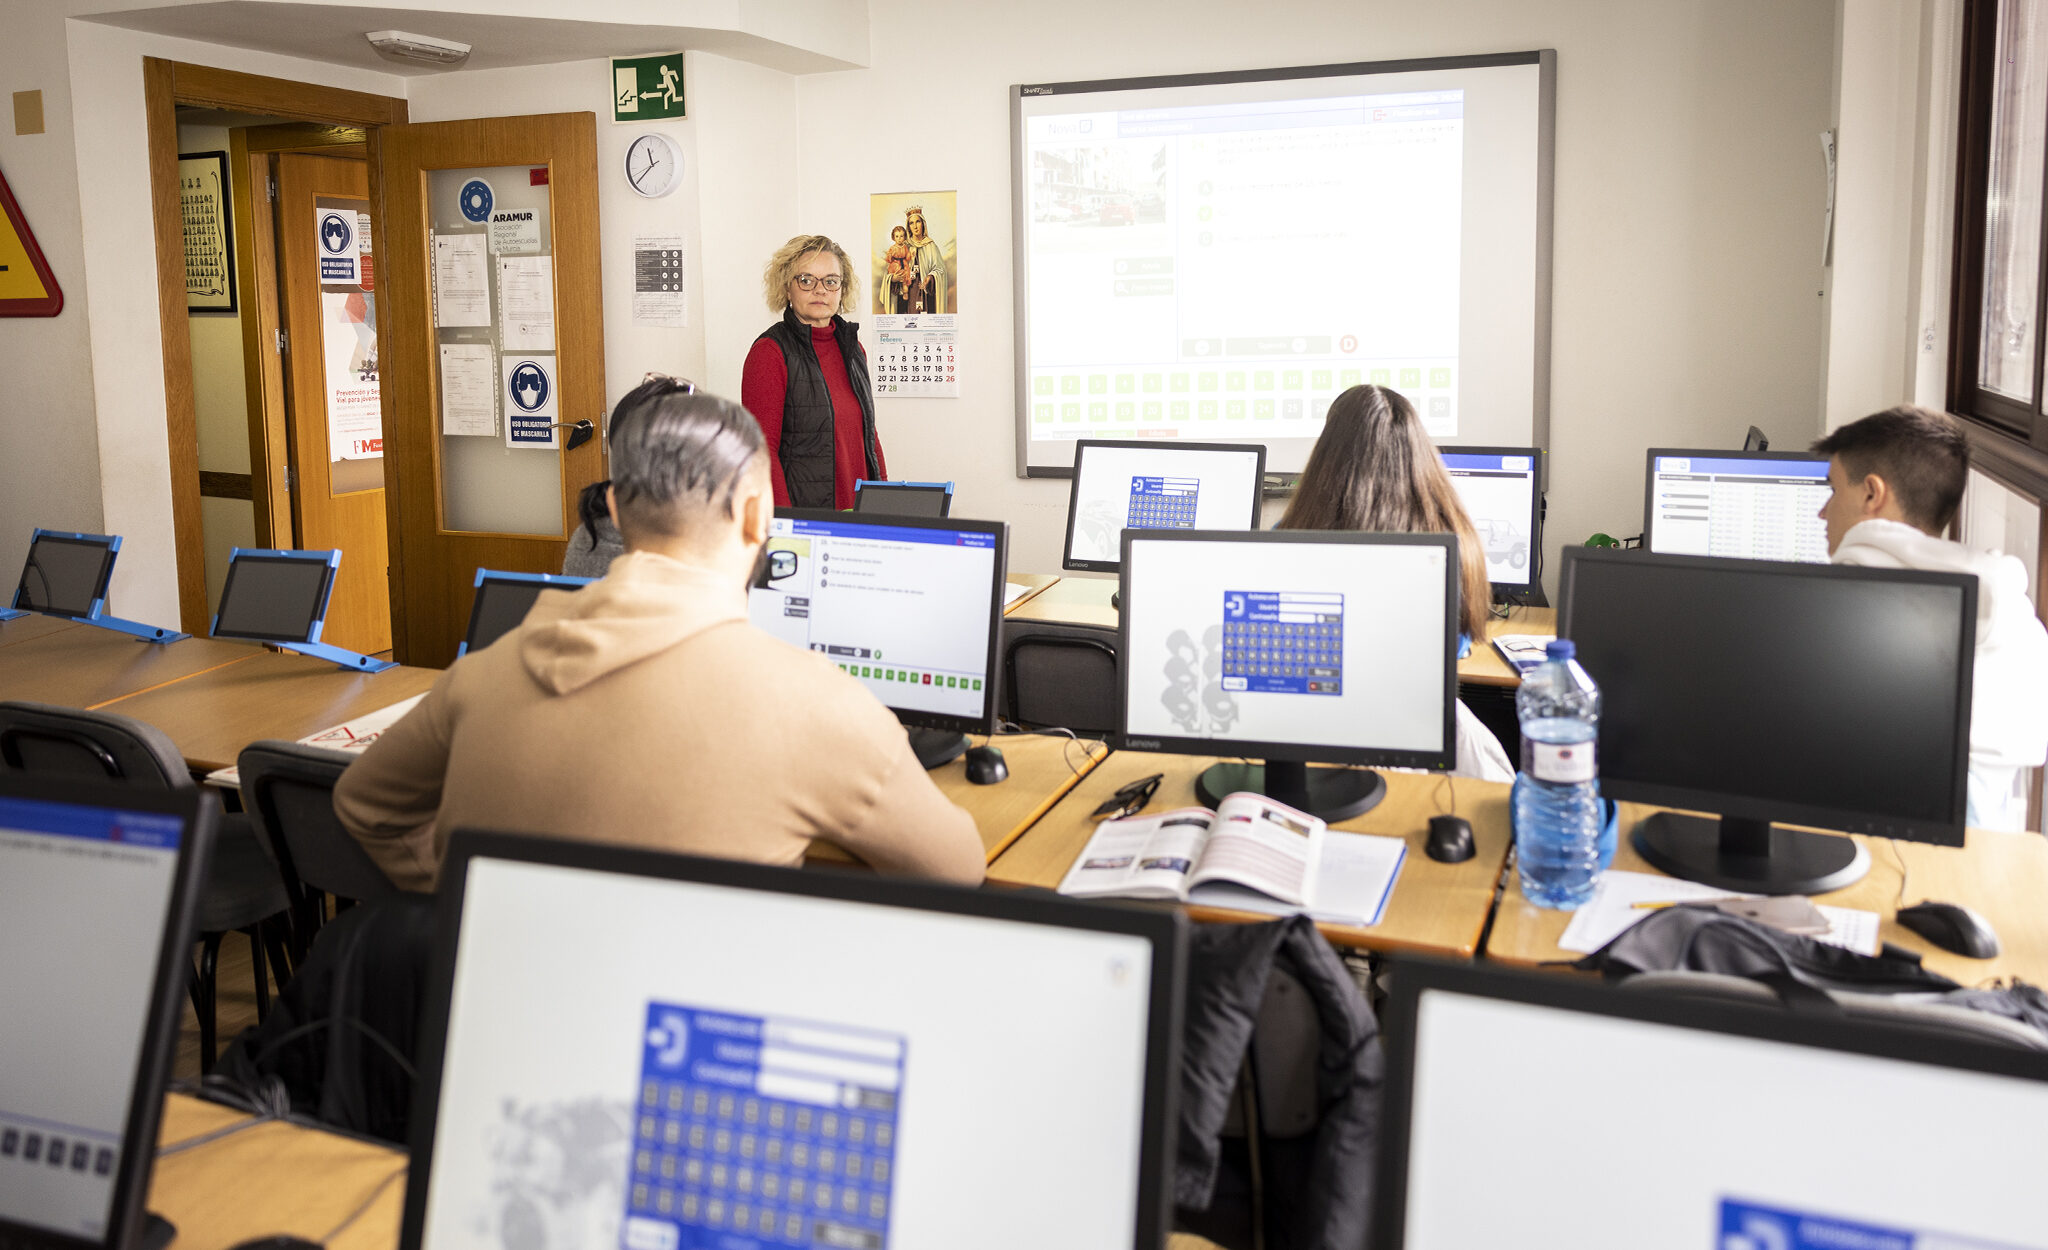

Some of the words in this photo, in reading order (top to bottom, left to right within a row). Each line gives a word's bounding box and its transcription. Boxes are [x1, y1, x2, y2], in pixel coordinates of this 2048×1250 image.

[492, 212, 533, 223] ARAMUR
[493, 231, 517, 239] Regional
[336, 388, 366, 396] Prevención
[347, 396, 361, 404] para
[511, 420, 521, 428] USO
[520, 430, 549, 438] MASCARILLA
[1125, 738, 1161, 749] Lenovo
